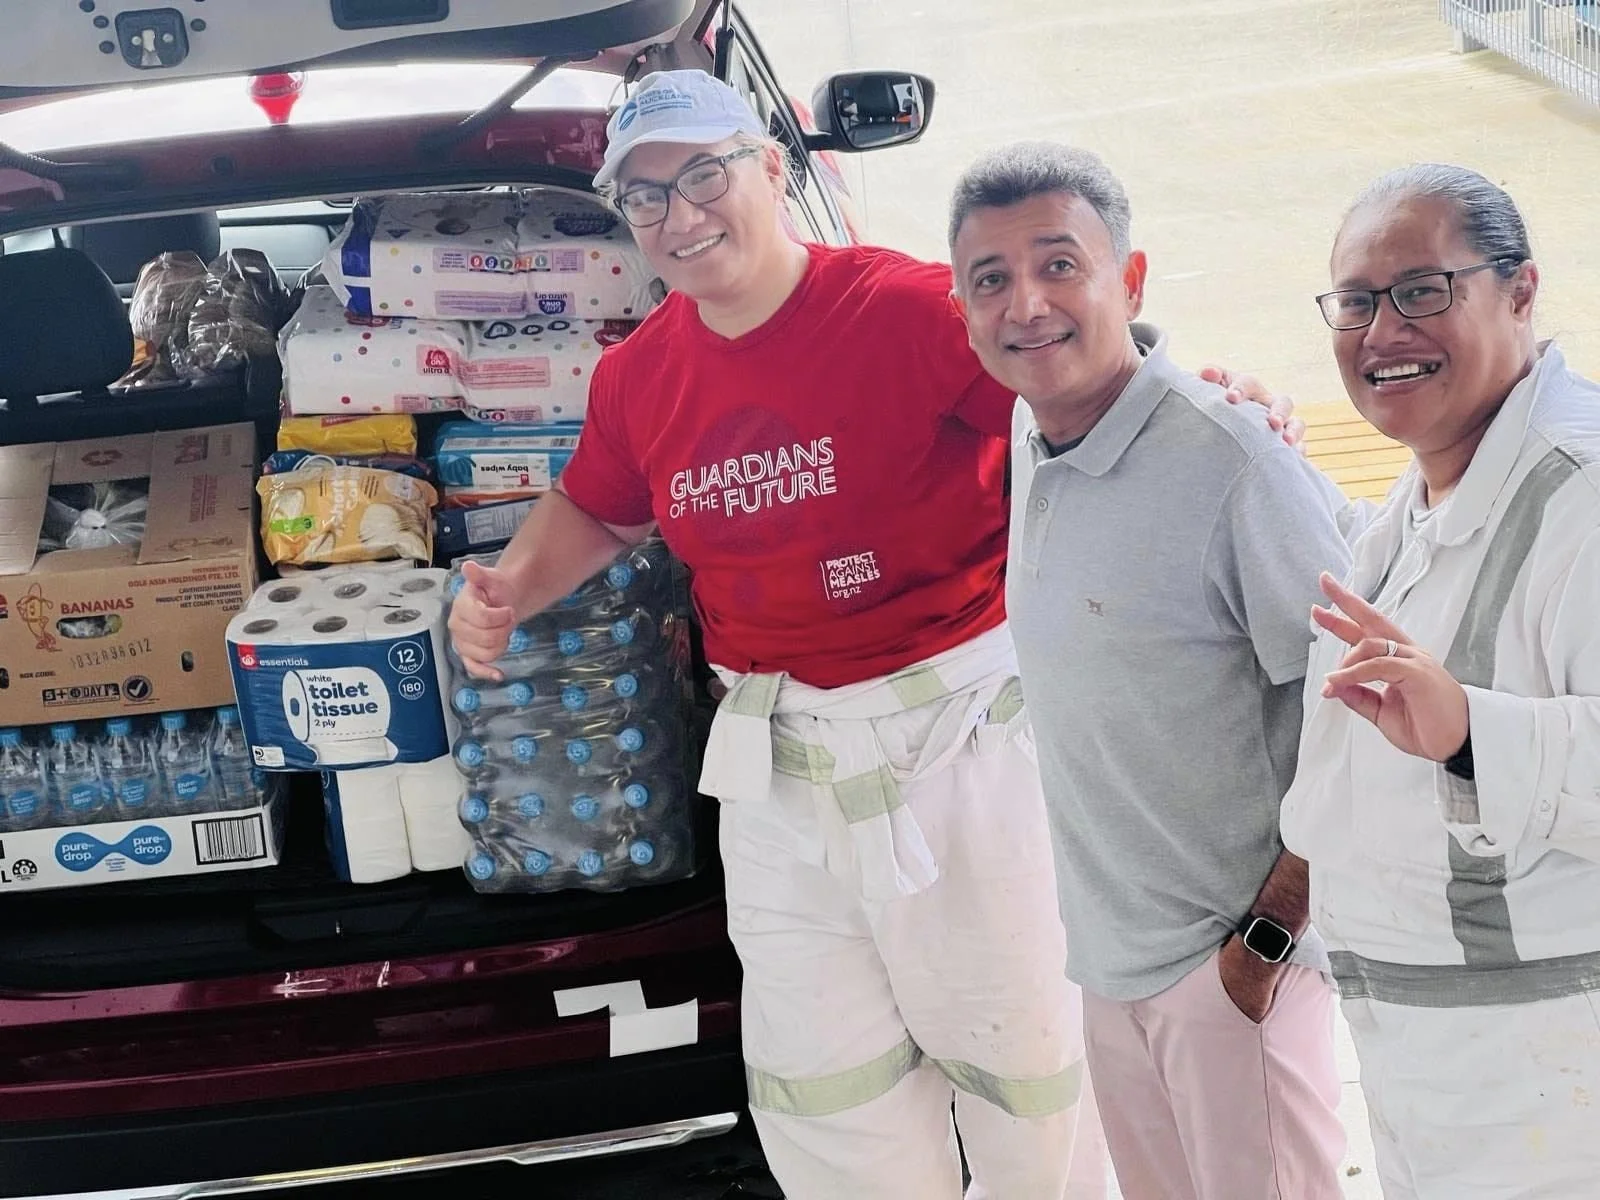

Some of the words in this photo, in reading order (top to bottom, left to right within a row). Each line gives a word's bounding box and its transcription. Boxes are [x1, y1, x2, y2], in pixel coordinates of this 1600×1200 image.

[481, 464, 506, 473] wipes
[507, 464, 529, 473] baby
[670, 436, 834, 500] GUARDIANS
[669, 501, 687, 519] OF
[691, 493, 719, 513] THE
[724, 466, 837, 517] FUTURE
[826, 551, 874, 570] PROTECT
[830, 560, 876, 578] AGAINST
[168, 574, 207, 584] HOLDINGS
[830, 569, 880, 589] MEASLES
[60, 597, 134, 615] BANANAS
[259, 657, 309, 667] essentials
[396, 648, 416, 664] 12
[398, 662, 419, 672] PACK
[306, 675, 332, 683] white
[309, 681, 369, 699] toilet
[402, 682, 421, 693] 180
[312, 700, 378, 717] tissue
[314, 719, 321, 727] 2
[322, 718, 336, 728] ply
[134, 844, 163, 856] drop
[64, 851, 92, 863] drop
